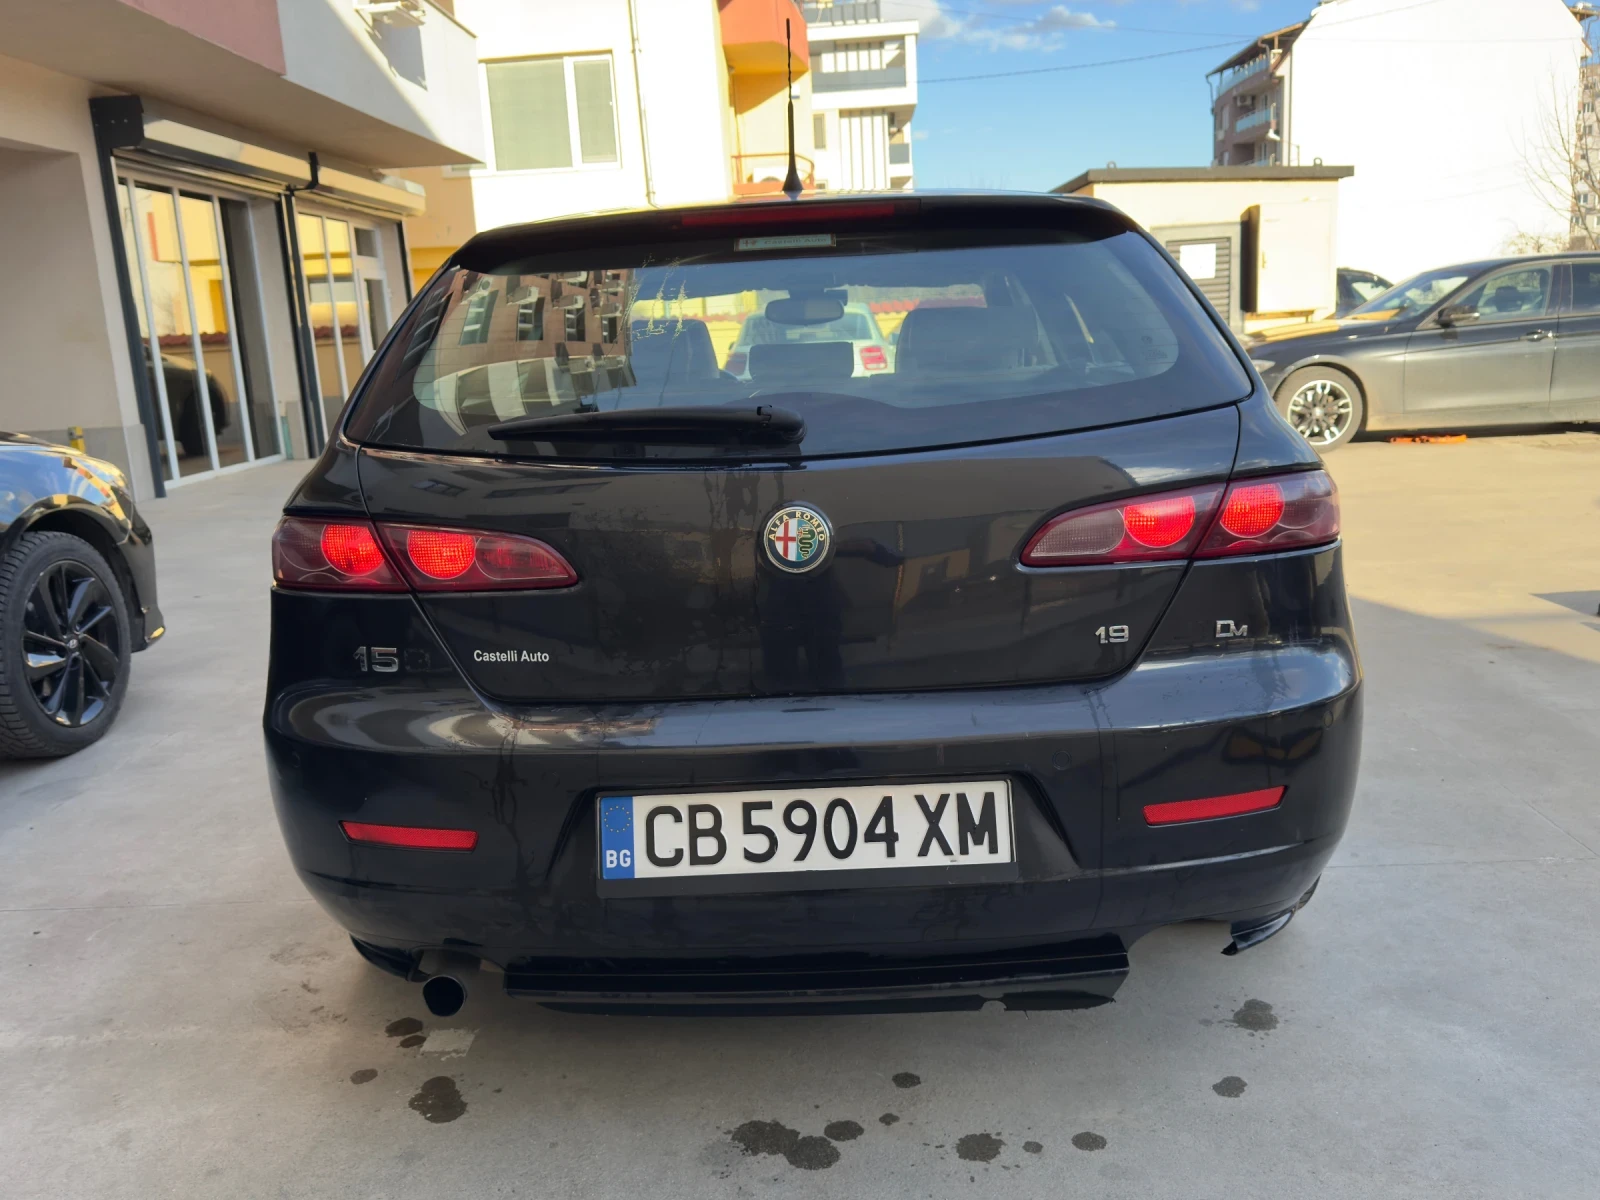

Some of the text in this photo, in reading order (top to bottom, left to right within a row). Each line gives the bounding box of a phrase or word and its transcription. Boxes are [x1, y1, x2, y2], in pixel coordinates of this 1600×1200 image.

[768, 511, 825, 541] ALFA ROMEO
[473, 649, 550, 662] Castelli Auto
[645, 792, 999, 868] CB 5904 XM
[606, 850, 632, 868] BG
